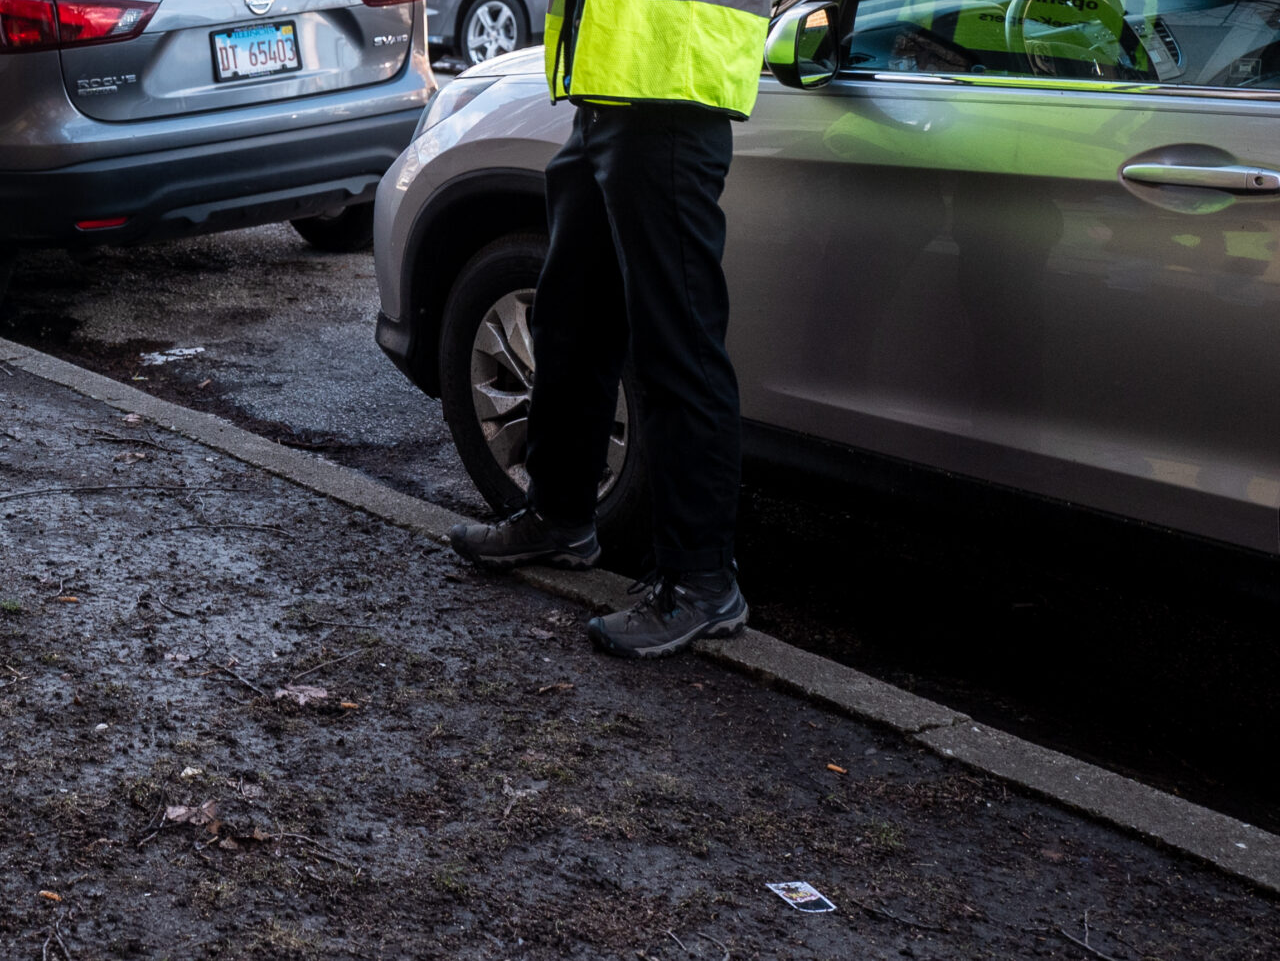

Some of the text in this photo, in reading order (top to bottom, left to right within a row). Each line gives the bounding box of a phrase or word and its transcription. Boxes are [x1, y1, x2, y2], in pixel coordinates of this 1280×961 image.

[219, 38, 297, 72] DT 65403
[77, 74, 137, 88] ROGUE
